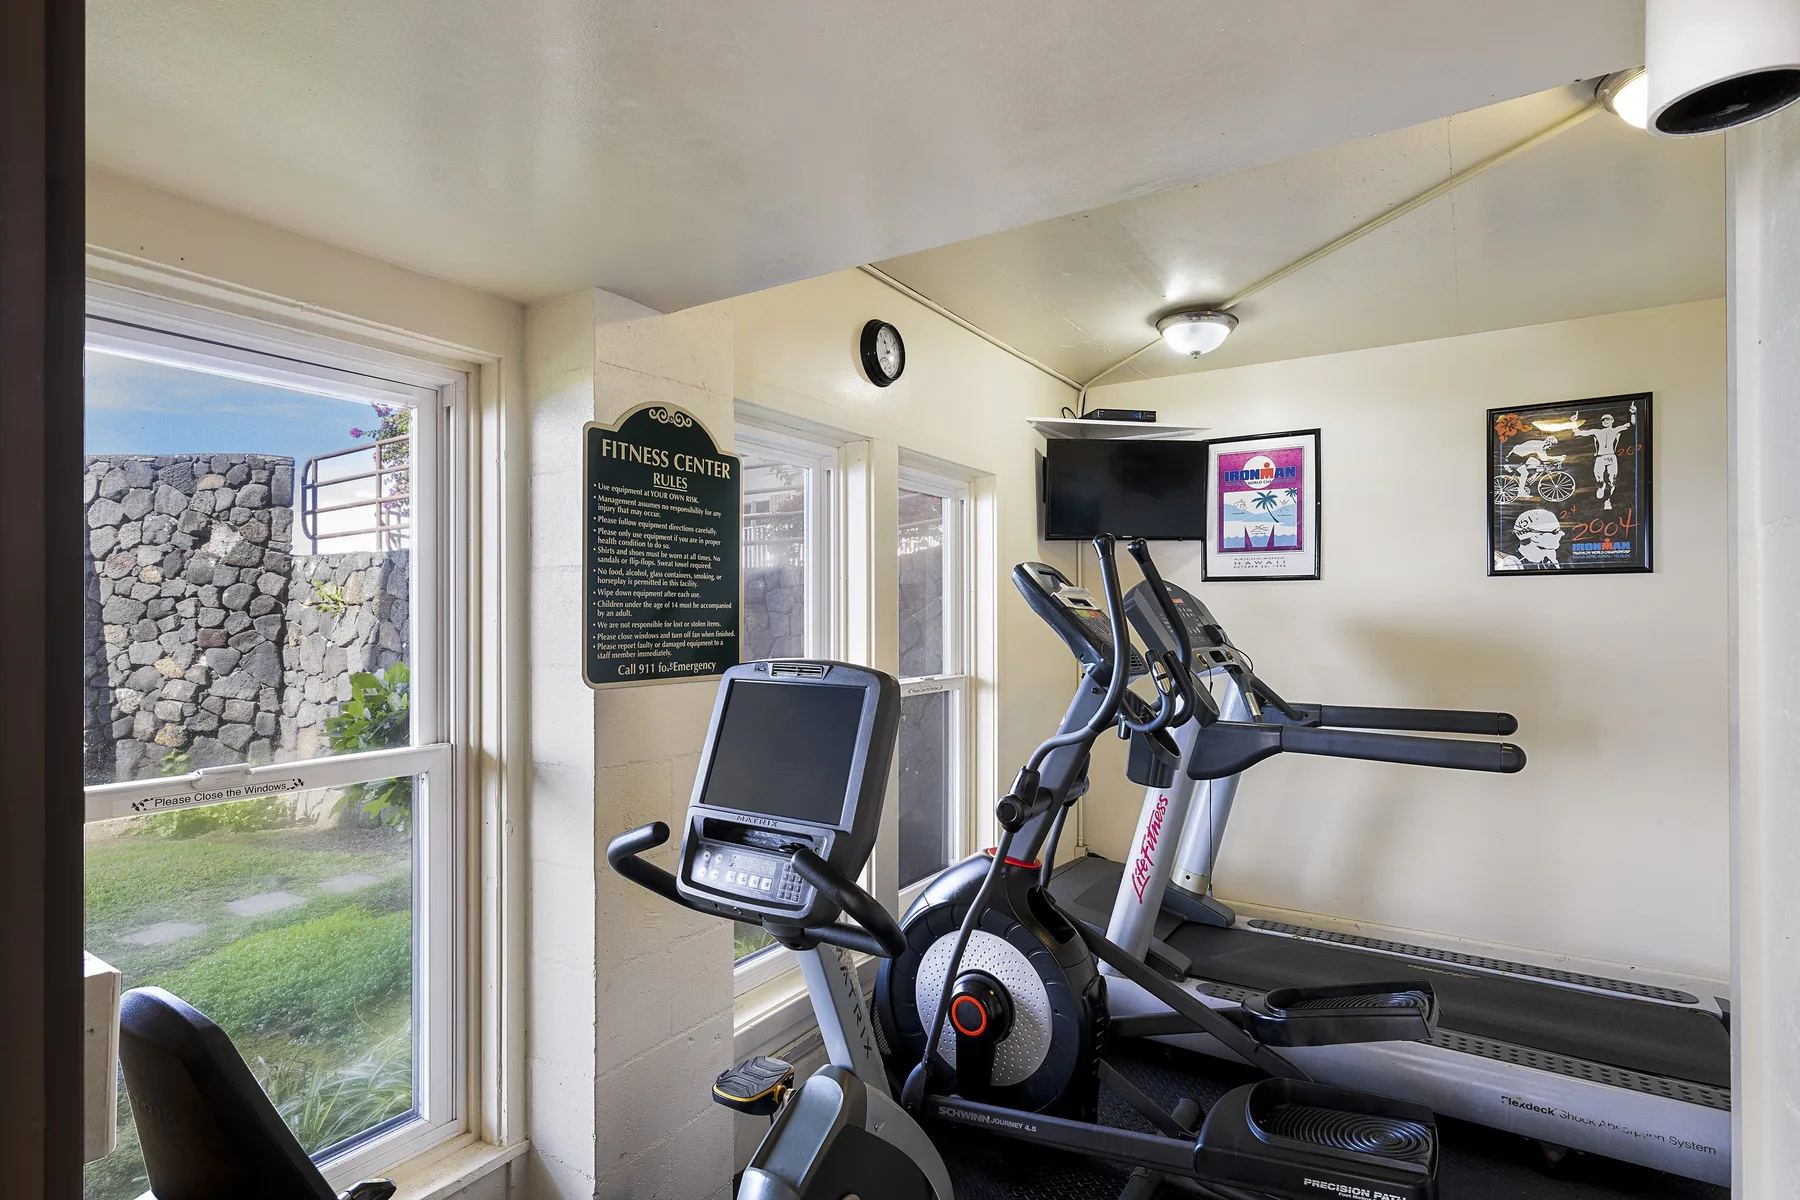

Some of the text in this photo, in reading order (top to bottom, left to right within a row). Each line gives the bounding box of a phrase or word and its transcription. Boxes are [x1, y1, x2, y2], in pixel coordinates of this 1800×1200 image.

[602, 438, 730, 479] FITNESS CENTER
[1224, 462, 1296, 482] IRONMAN
[654, 473, 687, 489] RULES
[598, 482, 610, 490] Use
[611, 486, 642, 495] equipment
[651, 490, 668, 499] YOUR
[669, 493, 684, 501] OWN
[598, 495, 636, 506] Management
[638, 501, 660, 509] assumes
[670, 505, 703, 516] responsibility
[598, 503, 615, 514] injury
[617, 506, 629, 514] that
[631, 509, 642, 517] may
[598, 515, 717, 536] Please follow equipment directions carefully.
[1572, 508, 1640, 541] 2004
[598, 527, 617, 536] Please
[618, 530, 631, 539] only
[644, 533, 672, 541] equipment
[598, 536, 616, 544] health
[598, 546, 615, 554] Shirts
[1572, 538, 1631, 551] IRONMAN
[630, 557, 656, 567] flip-flops.
[657, 559, 674, 567] Sweat
[690, 562, 712, 570] required.
[608, 568, 624, 576] food,
[625, 569, 648, 577] alcohol,
[650, 570, 663, 578] glass
[664, 571, 693, 579] containers,
[694, 573, 715, 581] smoking,
[597, 576, 626, 586] horseplay
[634, 578, 661, 586] permitted
[680, 580, 698, 588] facility.
[597, 588, 614, 598] Wipe
[615, 588, 632, 596] down
[633, 589, 662, 598] equipment
[700, 602, 732, 610] accompanied
[597, 609, 605, 618] by
[632, 621, 663, 629] responsible
[618, 643, 635, 651] report
[637, 641, 653, 650] faulty
[662, 641, 685, 649] damaged
[687, 640, 713, 648] equipment
[597, 651, 610, 659] staff
[637, 649, 672, 657] immediately.
[618, 662, 717, 675] Call 911 fo Emergency
[155, 782, 286, 807] Please Close the Windows
[737, 815, 778, 827] MATRIX
[939, 1106, 990, 1124] SCHWINN
[991, 1118, 1023, 1129] JOURNEY
[1559, 1110, 1596, 1126] Shock
[1669, 1136, 1716, 1155] System
[1304, 1178, 1369, 1197] PRECISION
